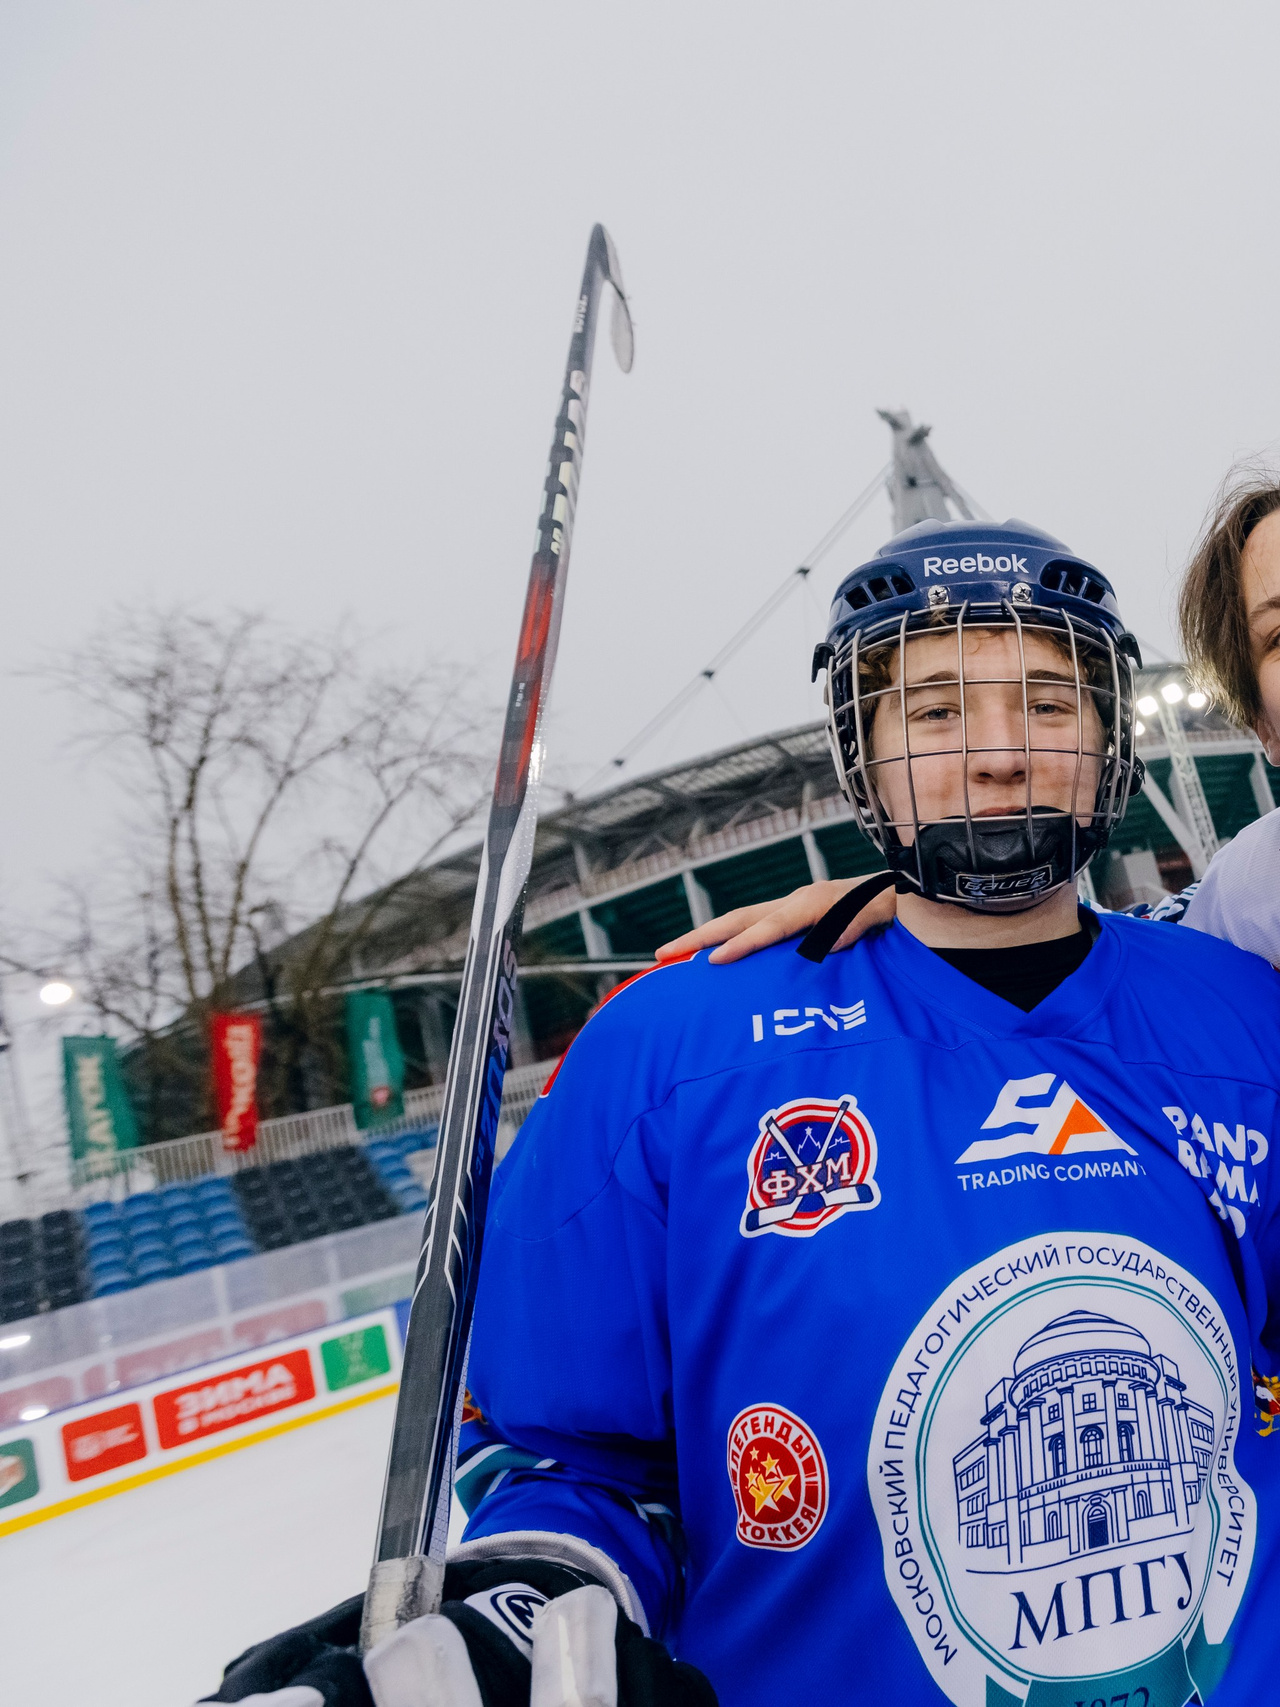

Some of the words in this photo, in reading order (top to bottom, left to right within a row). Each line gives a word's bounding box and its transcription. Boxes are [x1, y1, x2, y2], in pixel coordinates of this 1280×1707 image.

[923, 553, 1029, 577] Reebok
[762, 1152, 853, 1200] ФХМ
[957, 1163, 1050, 1191] TRADING
[1066, 1246, 1238, 1392] ГОСУДАРСТВЕННЫЙ
[885, 1245, 1061, 1451] ПЕДАГОГИЧЕСКИЙ
[731, 1415, 811, 1470] ЛЕГЕНДЫ
[740, 1506, 816, 1542] ХОККЕЯ
[877, 1460, 958, 1665] МОСКОВСКИЙ
[1008, 1551, 1193, 1650] МПГУ
